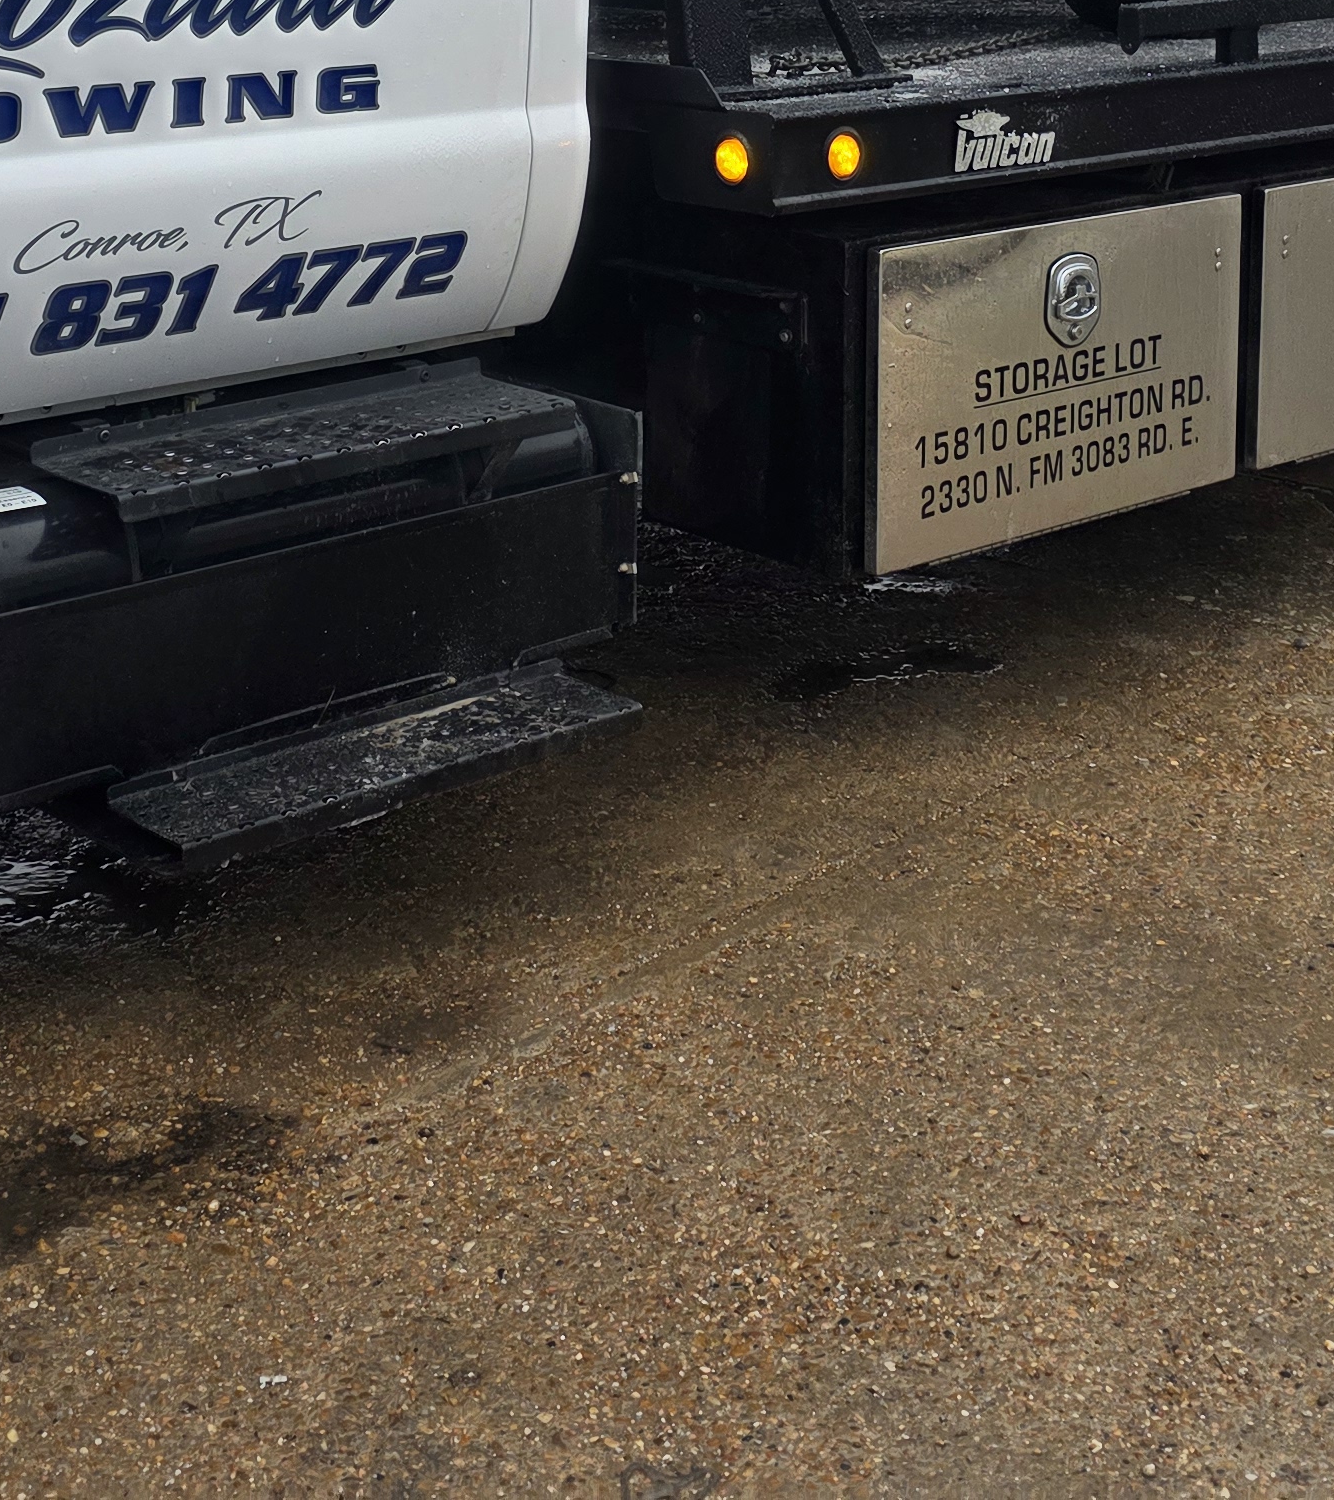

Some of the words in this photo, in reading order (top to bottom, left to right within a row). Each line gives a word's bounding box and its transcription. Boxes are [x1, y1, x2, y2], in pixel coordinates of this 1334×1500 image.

[13, 219, 188, 274] Conroe,
[214, 189, 323, 247] TX
[30, 264, 219, 356] 831
[234, 230, 468, 321] 4772
[974, 345, 1106, 403] STORAGE
[1114, 334, 1162, 373] LOT
[914, 418, 1008, 469] 15810
[1017, 382, 1164, 446] CREIGHTON
[1171, 374, 1211, 410] RD.
[920, 470, 988, 520] 2330
[996, 463, 1021, 499] N.
[1029, 449, 1064, 490] FM
[1071, 432, 1130, 477] 3083
[1137, 423, 1173, 460] RD.
[1181, 416, 1199, 447] E.
